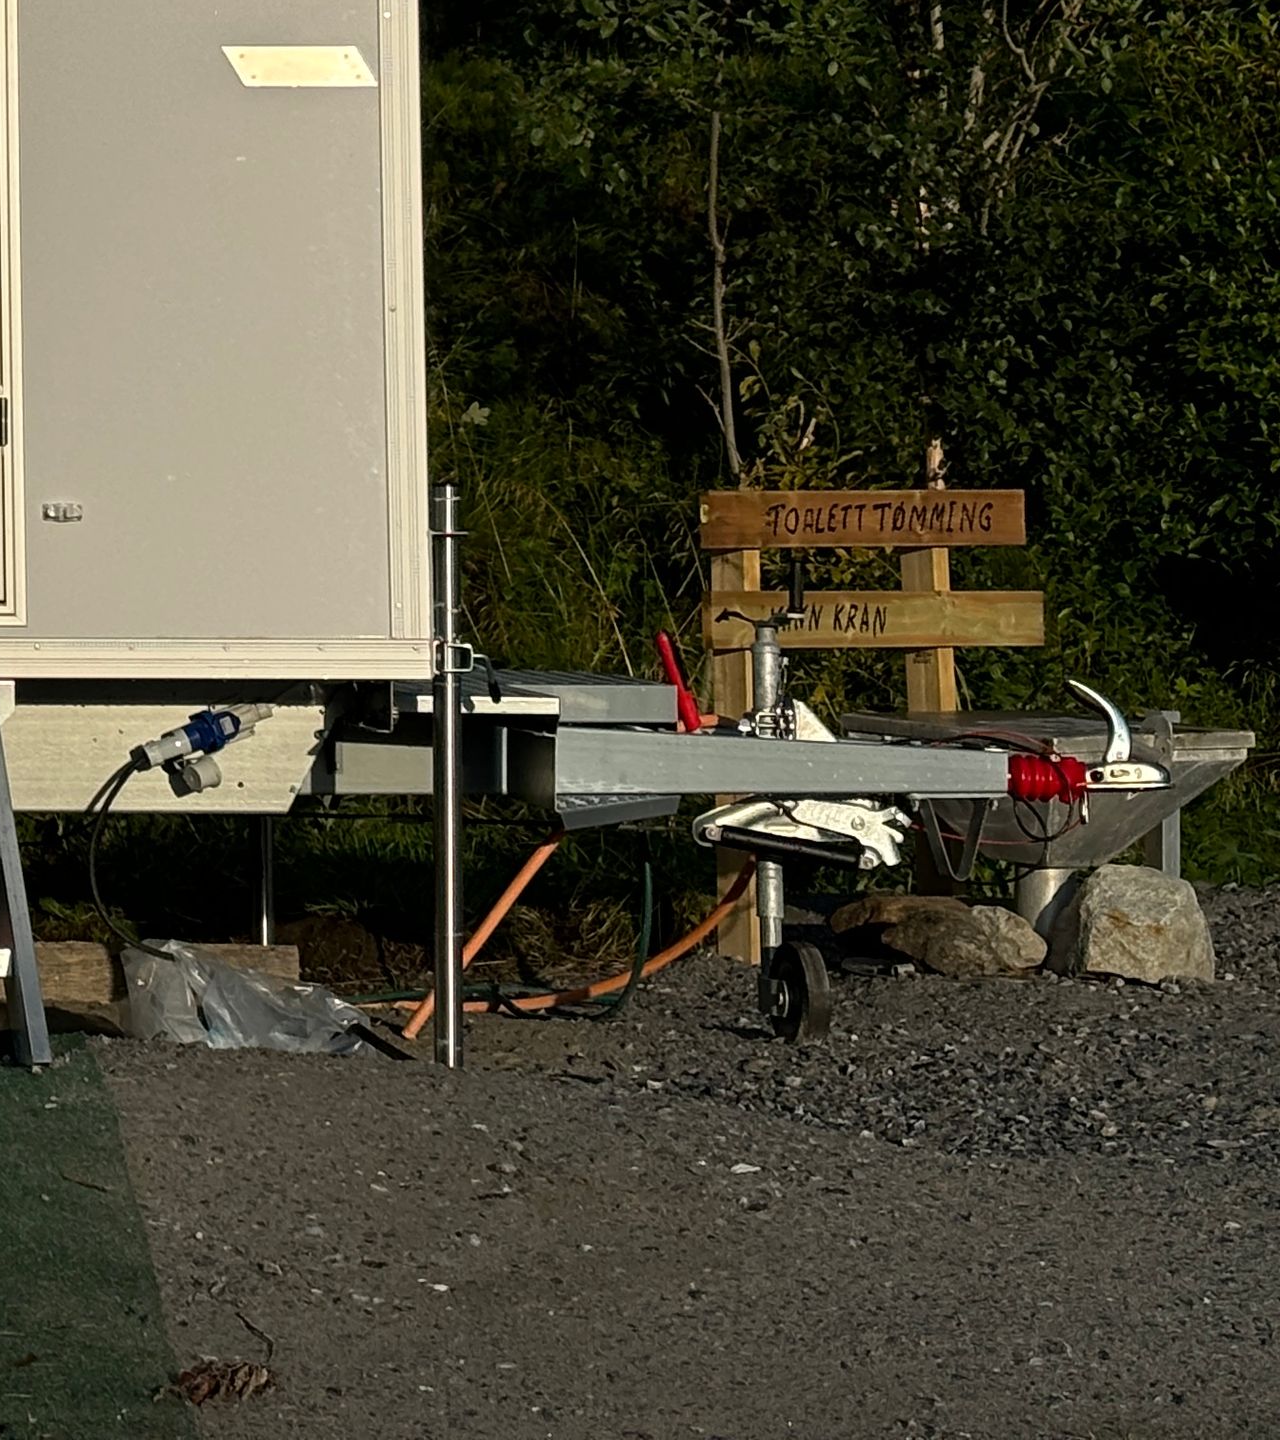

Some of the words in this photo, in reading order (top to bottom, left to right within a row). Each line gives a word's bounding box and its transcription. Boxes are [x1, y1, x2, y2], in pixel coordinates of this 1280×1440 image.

[767, 502, 867, 536] TOALETT
[872, 501, 994, 534] TØMMING
[833, 602, 888, 638] KRAN
